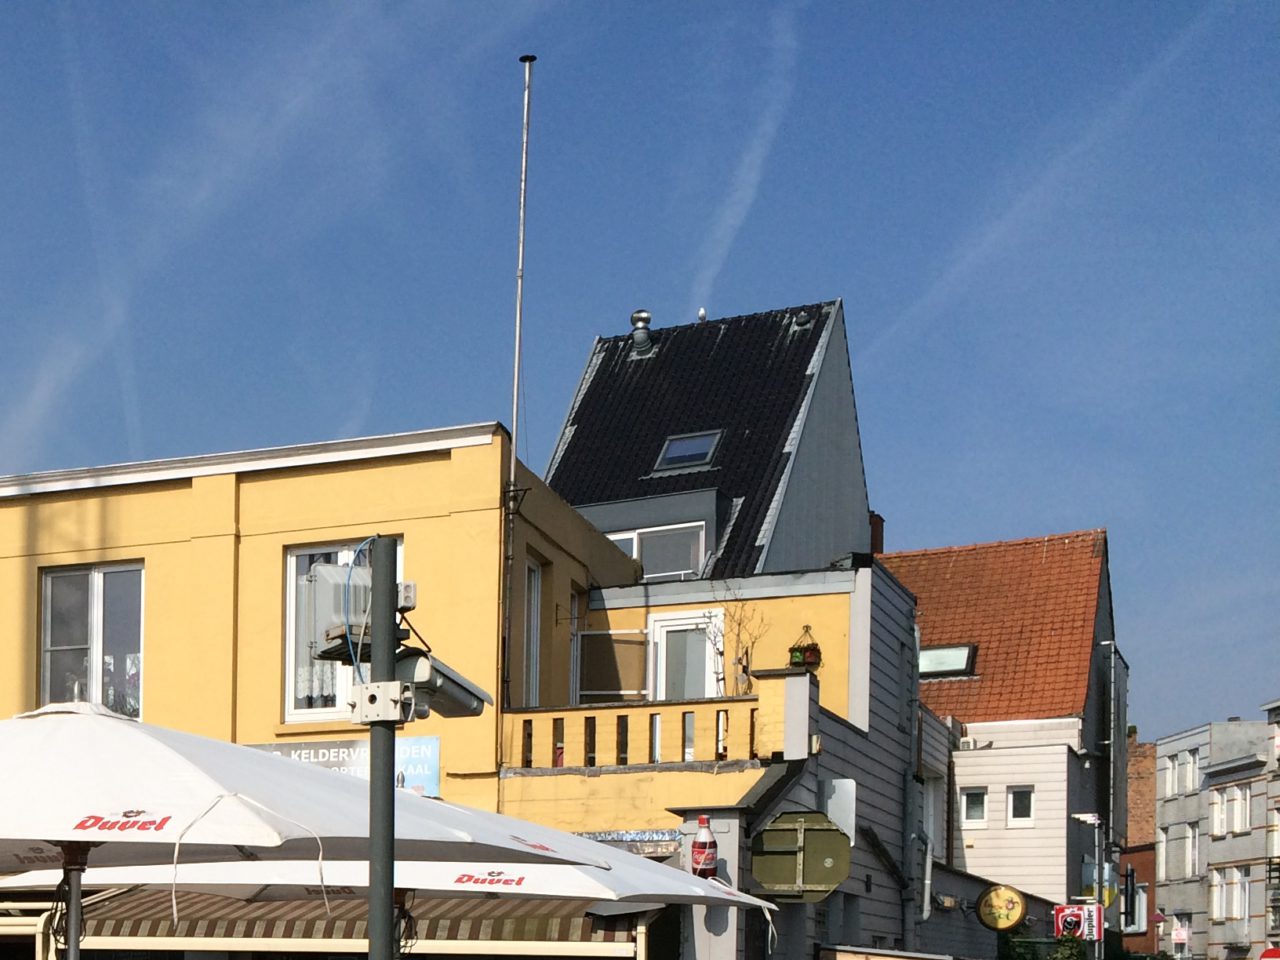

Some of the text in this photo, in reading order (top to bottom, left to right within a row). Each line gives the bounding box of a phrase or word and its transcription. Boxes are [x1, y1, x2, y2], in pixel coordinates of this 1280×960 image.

[291, 745, 432, 763] KELDERVRDEN
[73, 815, 172, 831] Duvel
[454, 873, 526, 886] Duvel
[1086, 907, 1096, 940] Jupiler
